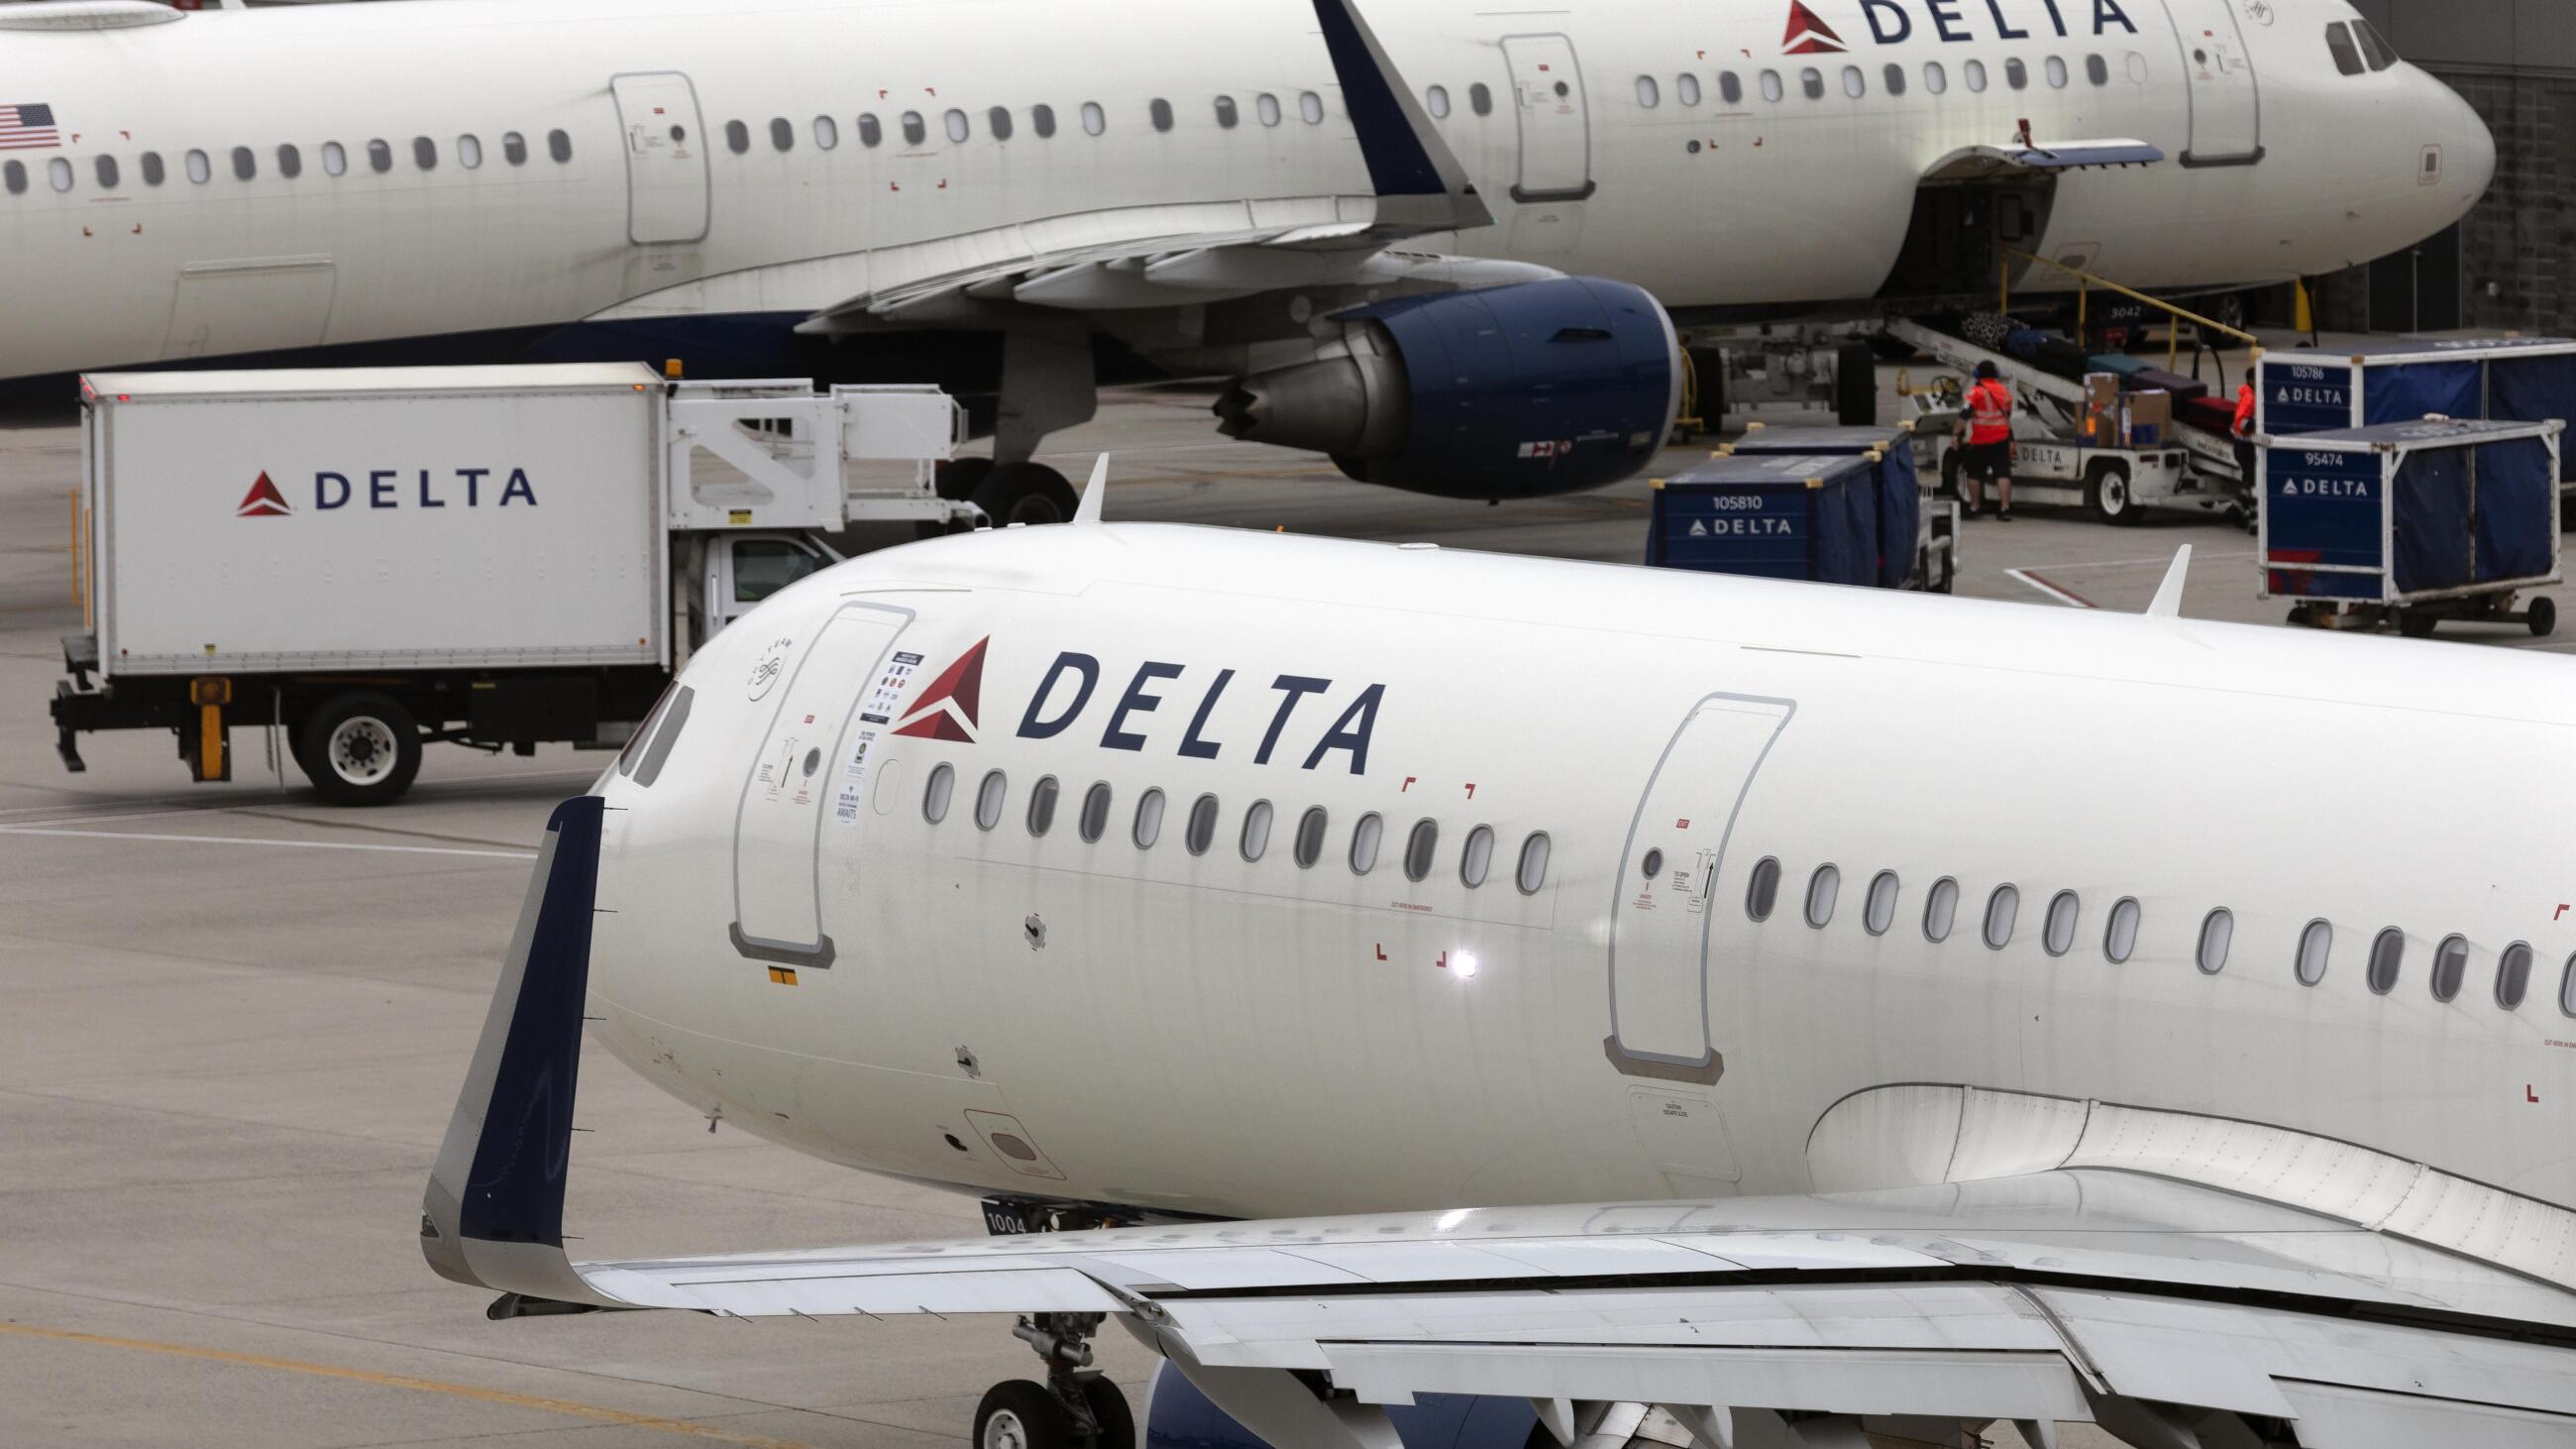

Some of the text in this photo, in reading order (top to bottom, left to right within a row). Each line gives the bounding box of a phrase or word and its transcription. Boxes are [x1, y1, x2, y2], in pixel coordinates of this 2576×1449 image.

[2291, 366, 2324, 380] 105786
[2293, 388, 2342, 404] DELTA
[2022, 445, 2062, 464] DELTA
[2306, 453, 2344, 467] 95474
[315, 468, 538, 510] DELTA
[2304, 478, 2368, 497] DELTA
[1712, 496, 1764, 510] 105810
[1714, 519, 1792, 534] DELTA
[1015, 650, 1387, 776] DELTA
[987, 1212, 1027, 1235] 1004
